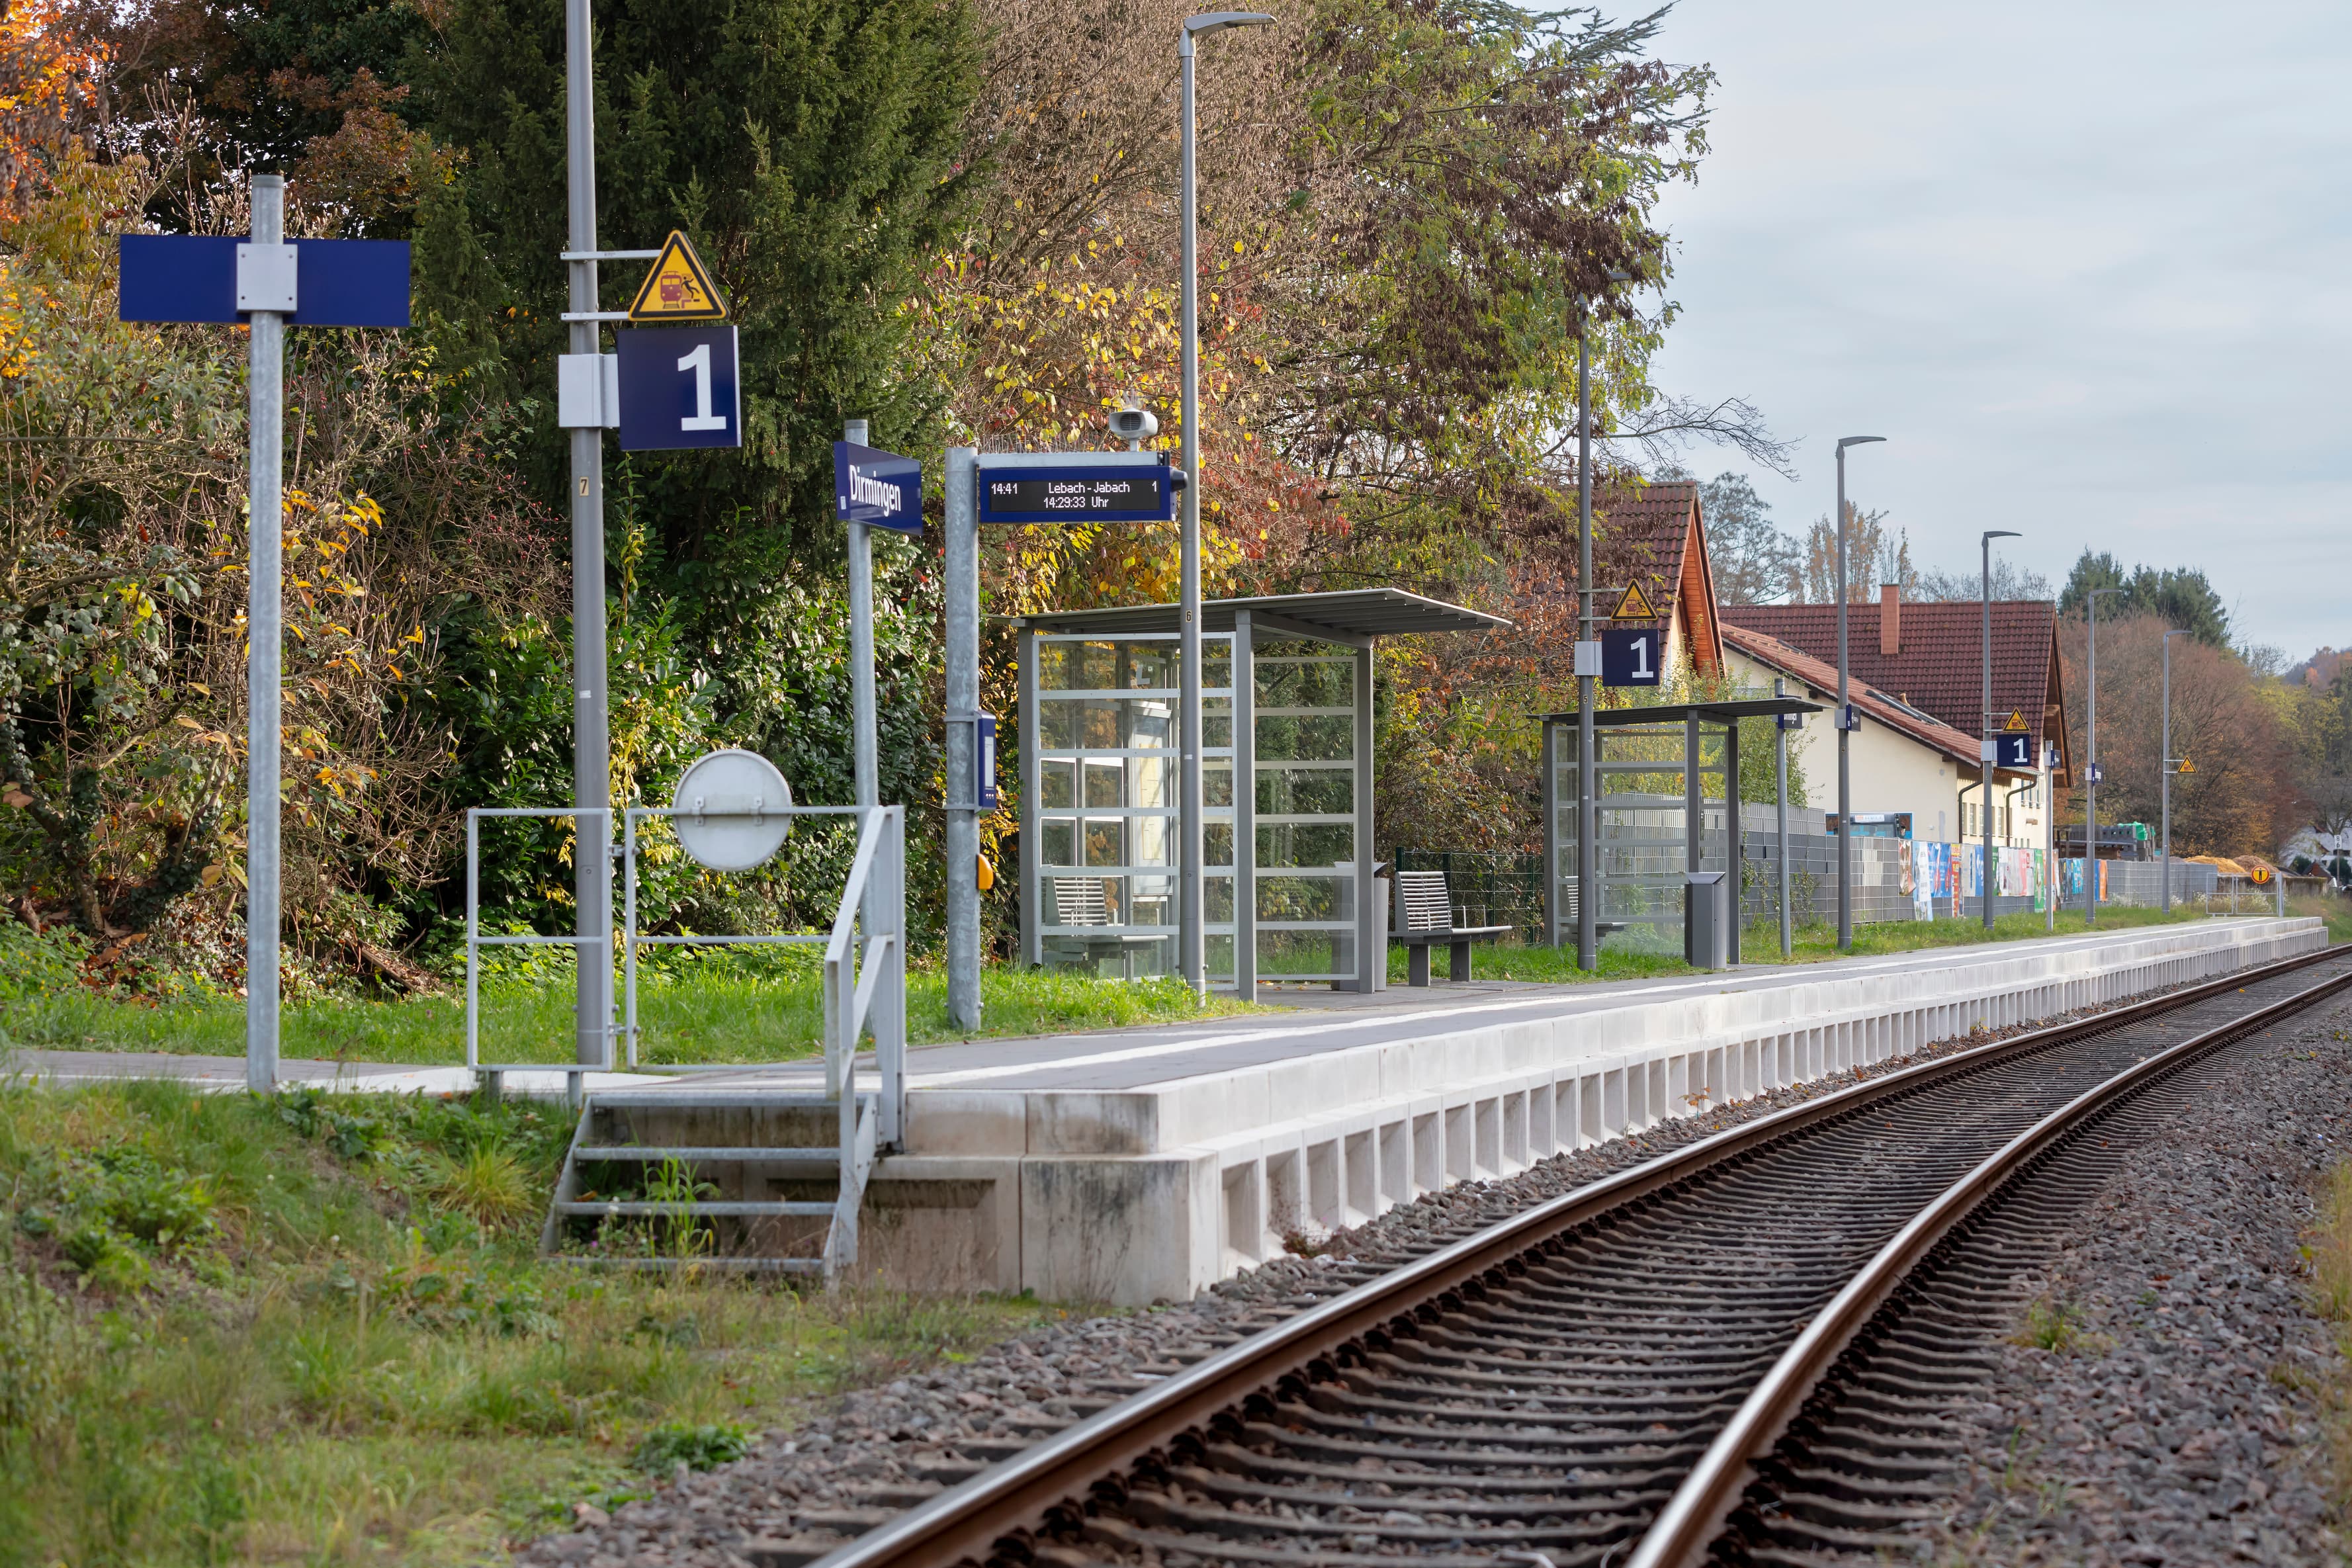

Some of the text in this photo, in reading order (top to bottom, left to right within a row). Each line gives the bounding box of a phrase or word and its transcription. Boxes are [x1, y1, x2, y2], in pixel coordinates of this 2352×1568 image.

[677, 344, 726, 431] 1
[580, 479, 587, 494] 7
[849, 464, 901, 517] Dirmingen
[991, 483, 1018, 494] 14:41
[1152, 480, 1157, 492] 1
[1043, 496, 1109, 508] 14:29:33 Uhr
[1186, 611, 1192, 622] 6
[1630, 637, 1653, 678] 1
[2013, 738, 2028, 763] 1
